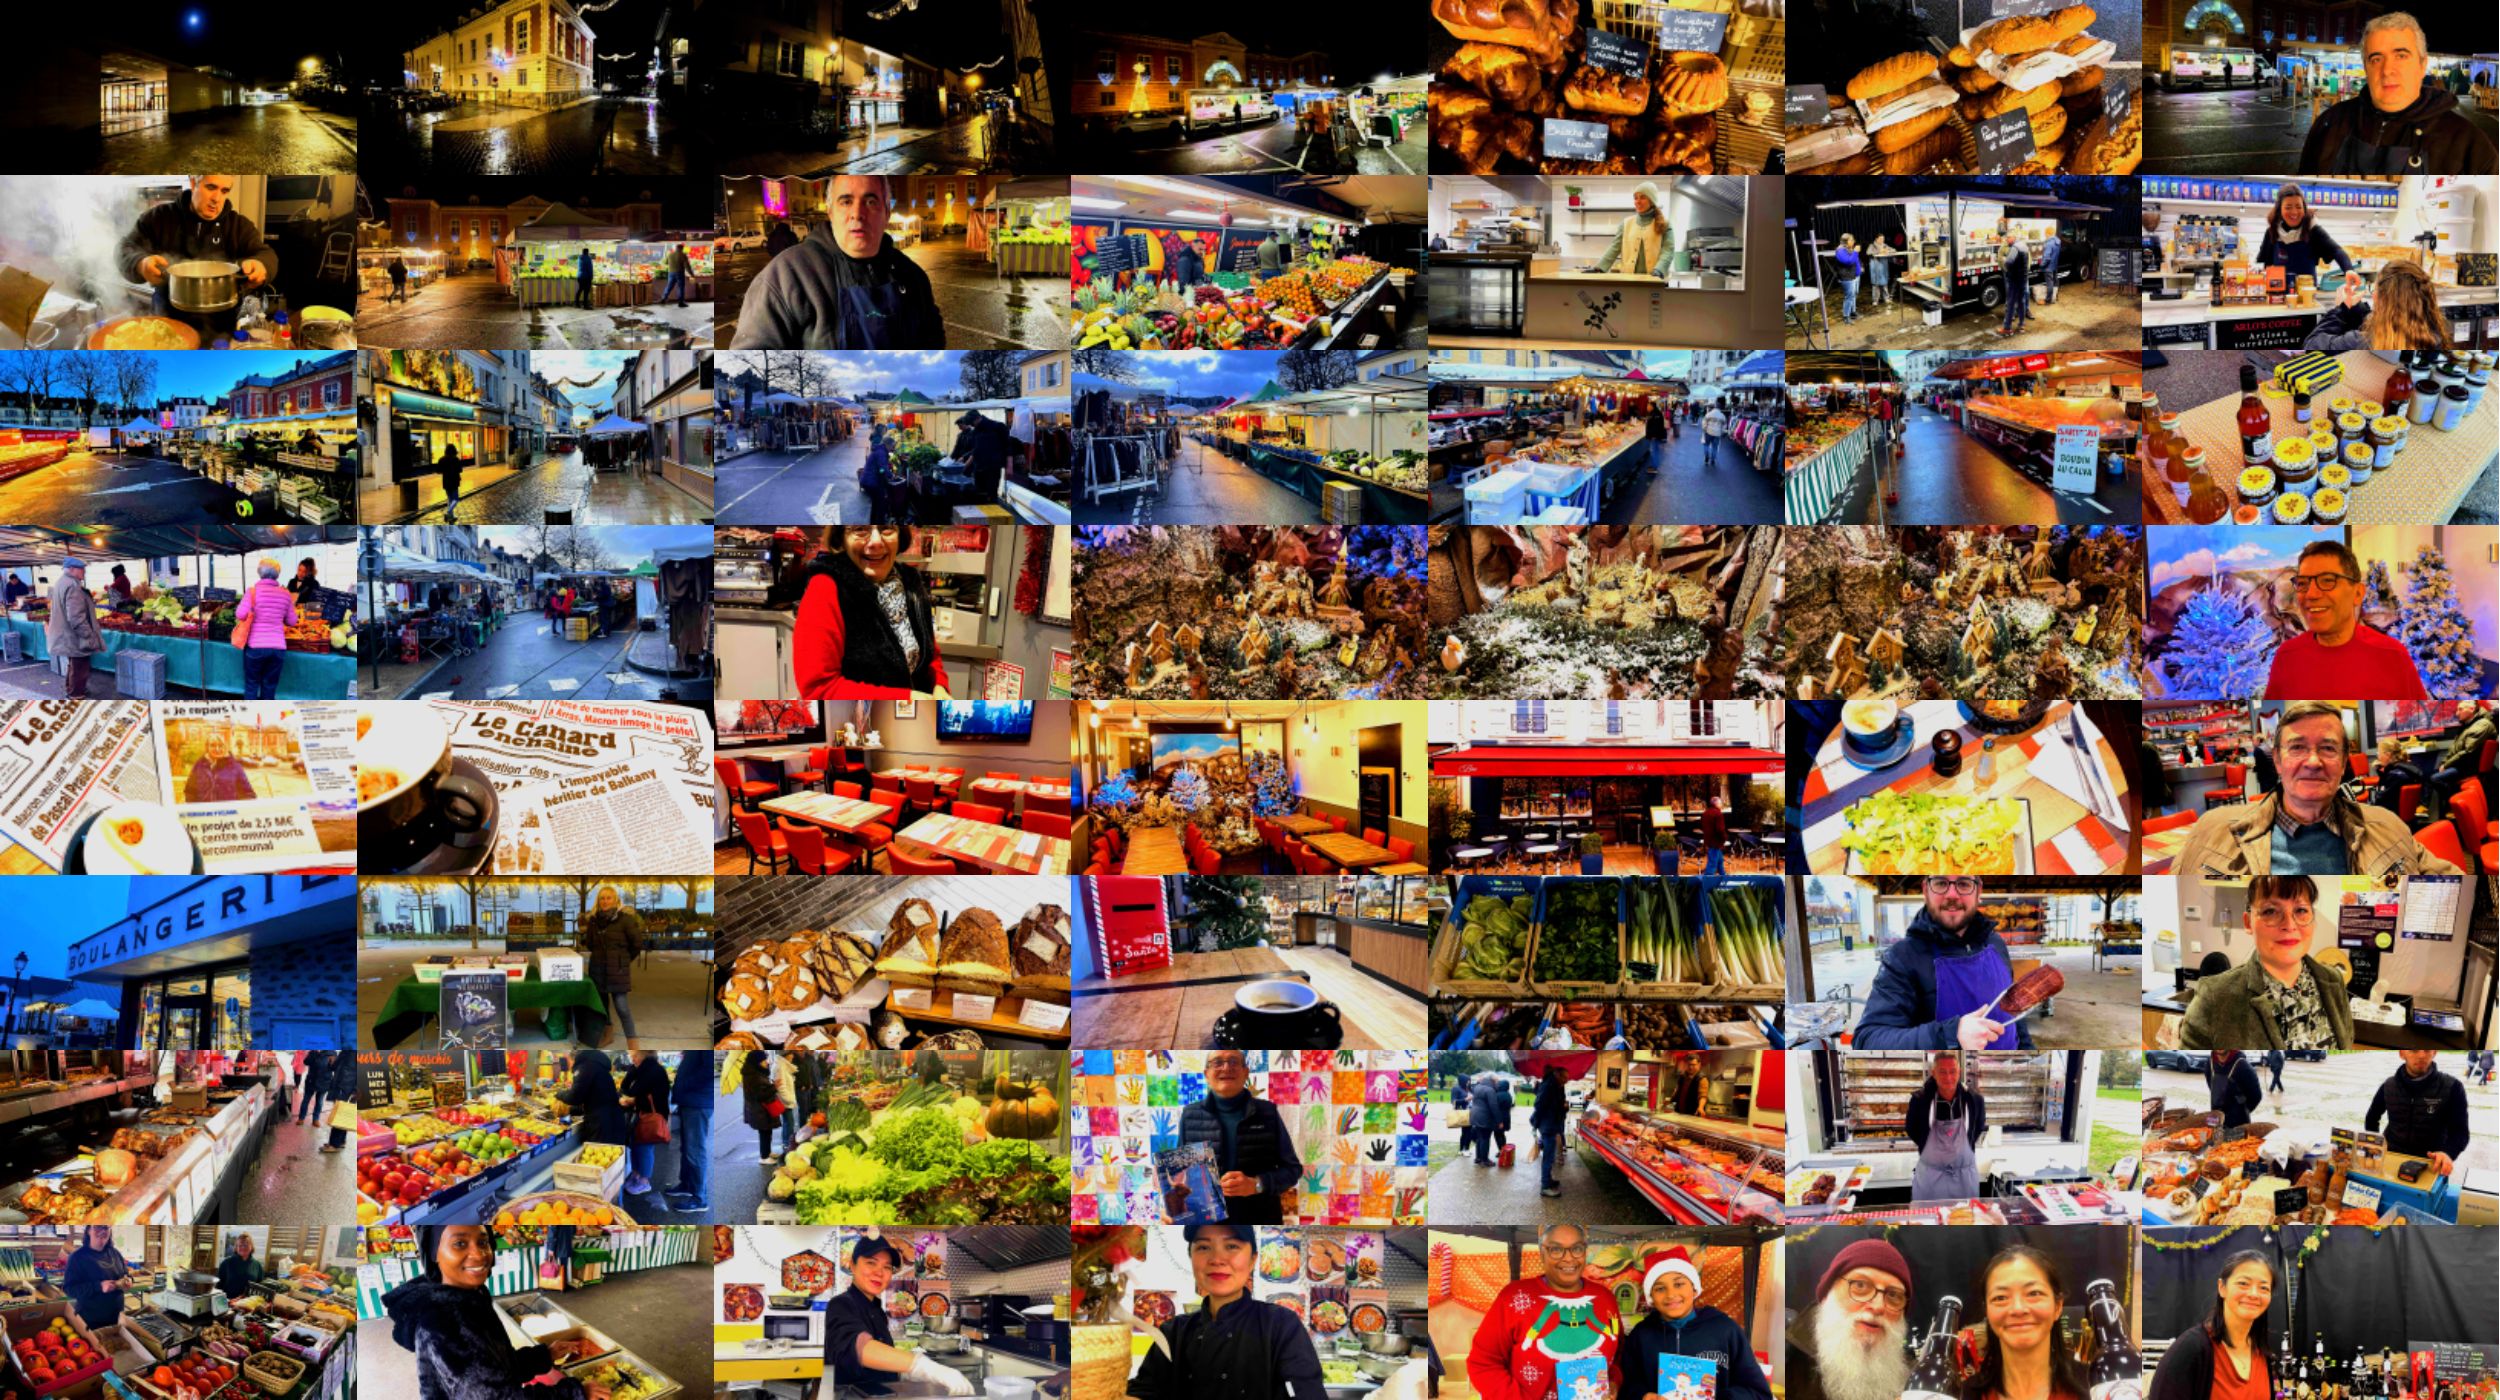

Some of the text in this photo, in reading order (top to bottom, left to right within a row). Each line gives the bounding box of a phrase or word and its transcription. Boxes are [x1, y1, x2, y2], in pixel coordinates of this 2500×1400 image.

[2249, 331, 2288, 340] Artisan
[189, 706, 229, 716] repars
[592, 706, 629, 717] marcher
[632, 708, 652, 719] sous
[665, 714, 688, 726] pluie
[584, 714, 618, 727] Macron
[11, 716, 46, 746] Le
[471, 711, 617, 750] Le Canard
[65, 763, 95, 795] Praud
[530, 766, 551, 779] des
[559, 763, 631, 790] L'impayable
[544, 768, 658, 808] héritier de Balkany
[12, 796, 42, 827] Macron
[38, 790, 75, 826] Pascal
[30, 824, 49, 842] de
[201, 820, 236, 834] projet
[238, 819, 252, 829] de
[201, 829, 305, 845] centre omnisports
[388, 1051, 405, 1065] de
[367, 1071, 384, 1079] LUN
[369, 1080, 386, 1088] MER
[369, 1089, 387, 1097] VEN
[371, 1098, 388, 1106] SAM
